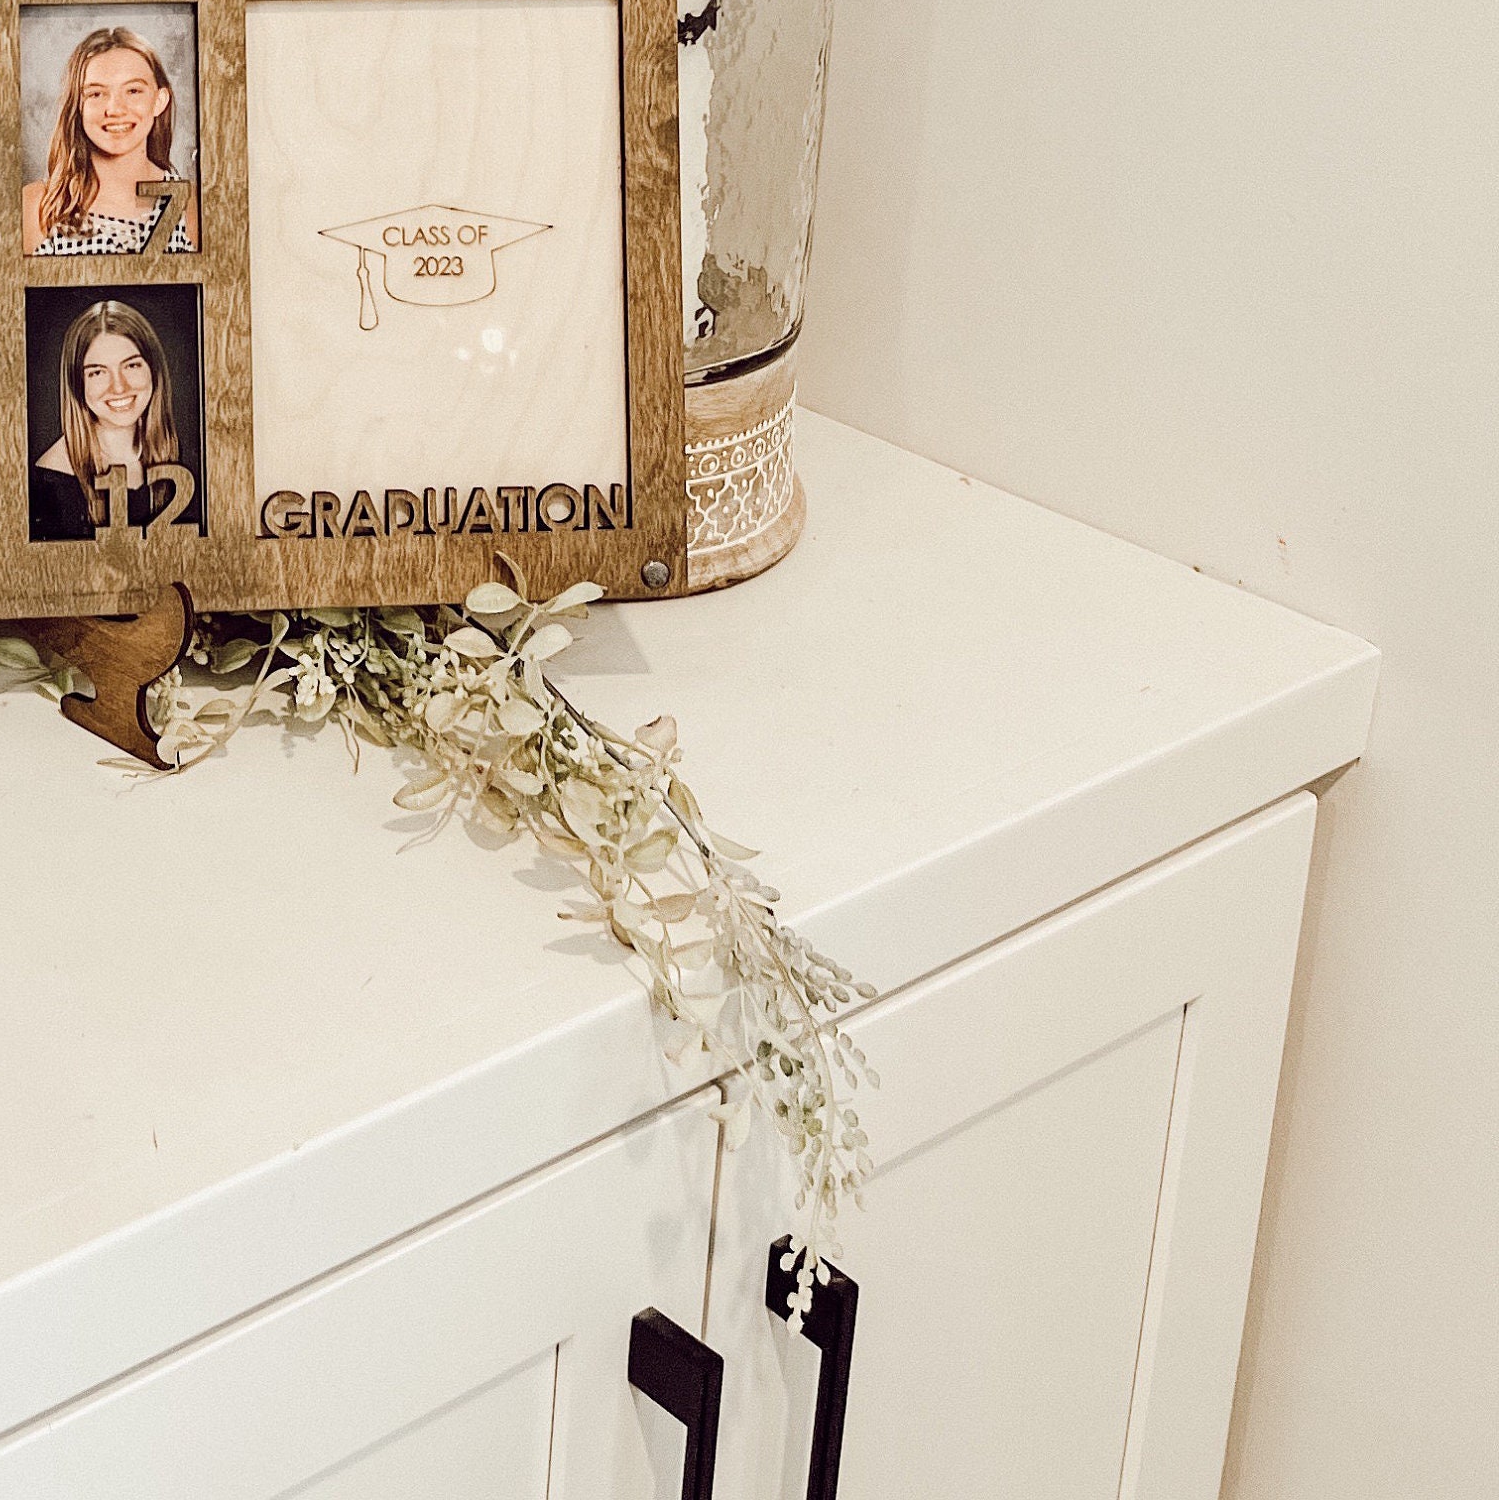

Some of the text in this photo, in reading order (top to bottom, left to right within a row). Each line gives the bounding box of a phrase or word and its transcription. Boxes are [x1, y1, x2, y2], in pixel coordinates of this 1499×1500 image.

[135, 180, 192, 255] 7
[382, 224, 489, 248] CLASS OF
[413, 256, 465, 278] 2023
[92, 463, 197, 541] 12
[258, 483, 633, 539] GRADUATION
